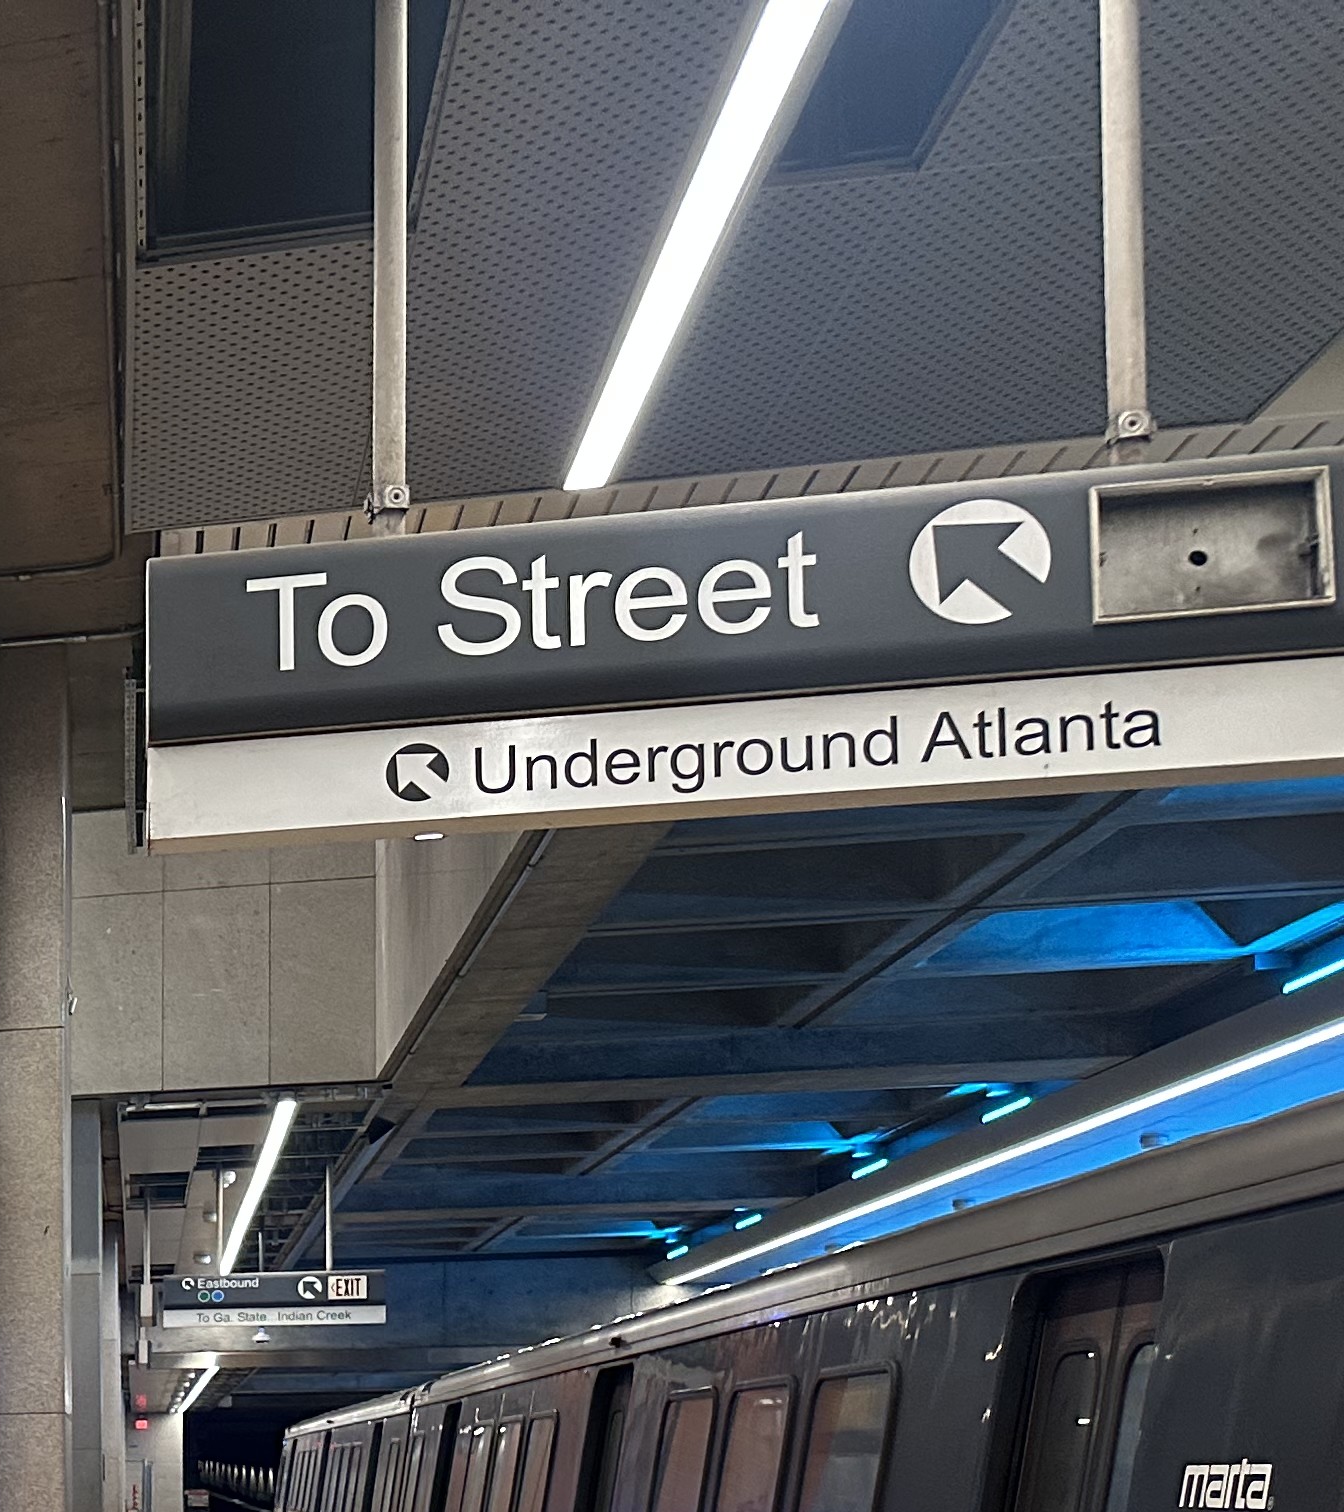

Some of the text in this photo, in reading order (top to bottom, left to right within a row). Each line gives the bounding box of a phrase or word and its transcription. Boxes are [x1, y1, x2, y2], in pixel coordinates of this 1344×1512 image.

[246, 531, 820, 672] To Street
[473, 700, 1162, 797] Underground Atlanta
[197, 1277, 259, 1289] Eastbound
[335, 1278, 362, 1297] EXIT
[196, 1312, 210, 1323] To
[237, 1311, 267, 1322] State
[277, 1311, 313, 1322] Indian
[316, 1310, 352, 1321] Creek
[1178, 1458, 1272, 1511] marta
